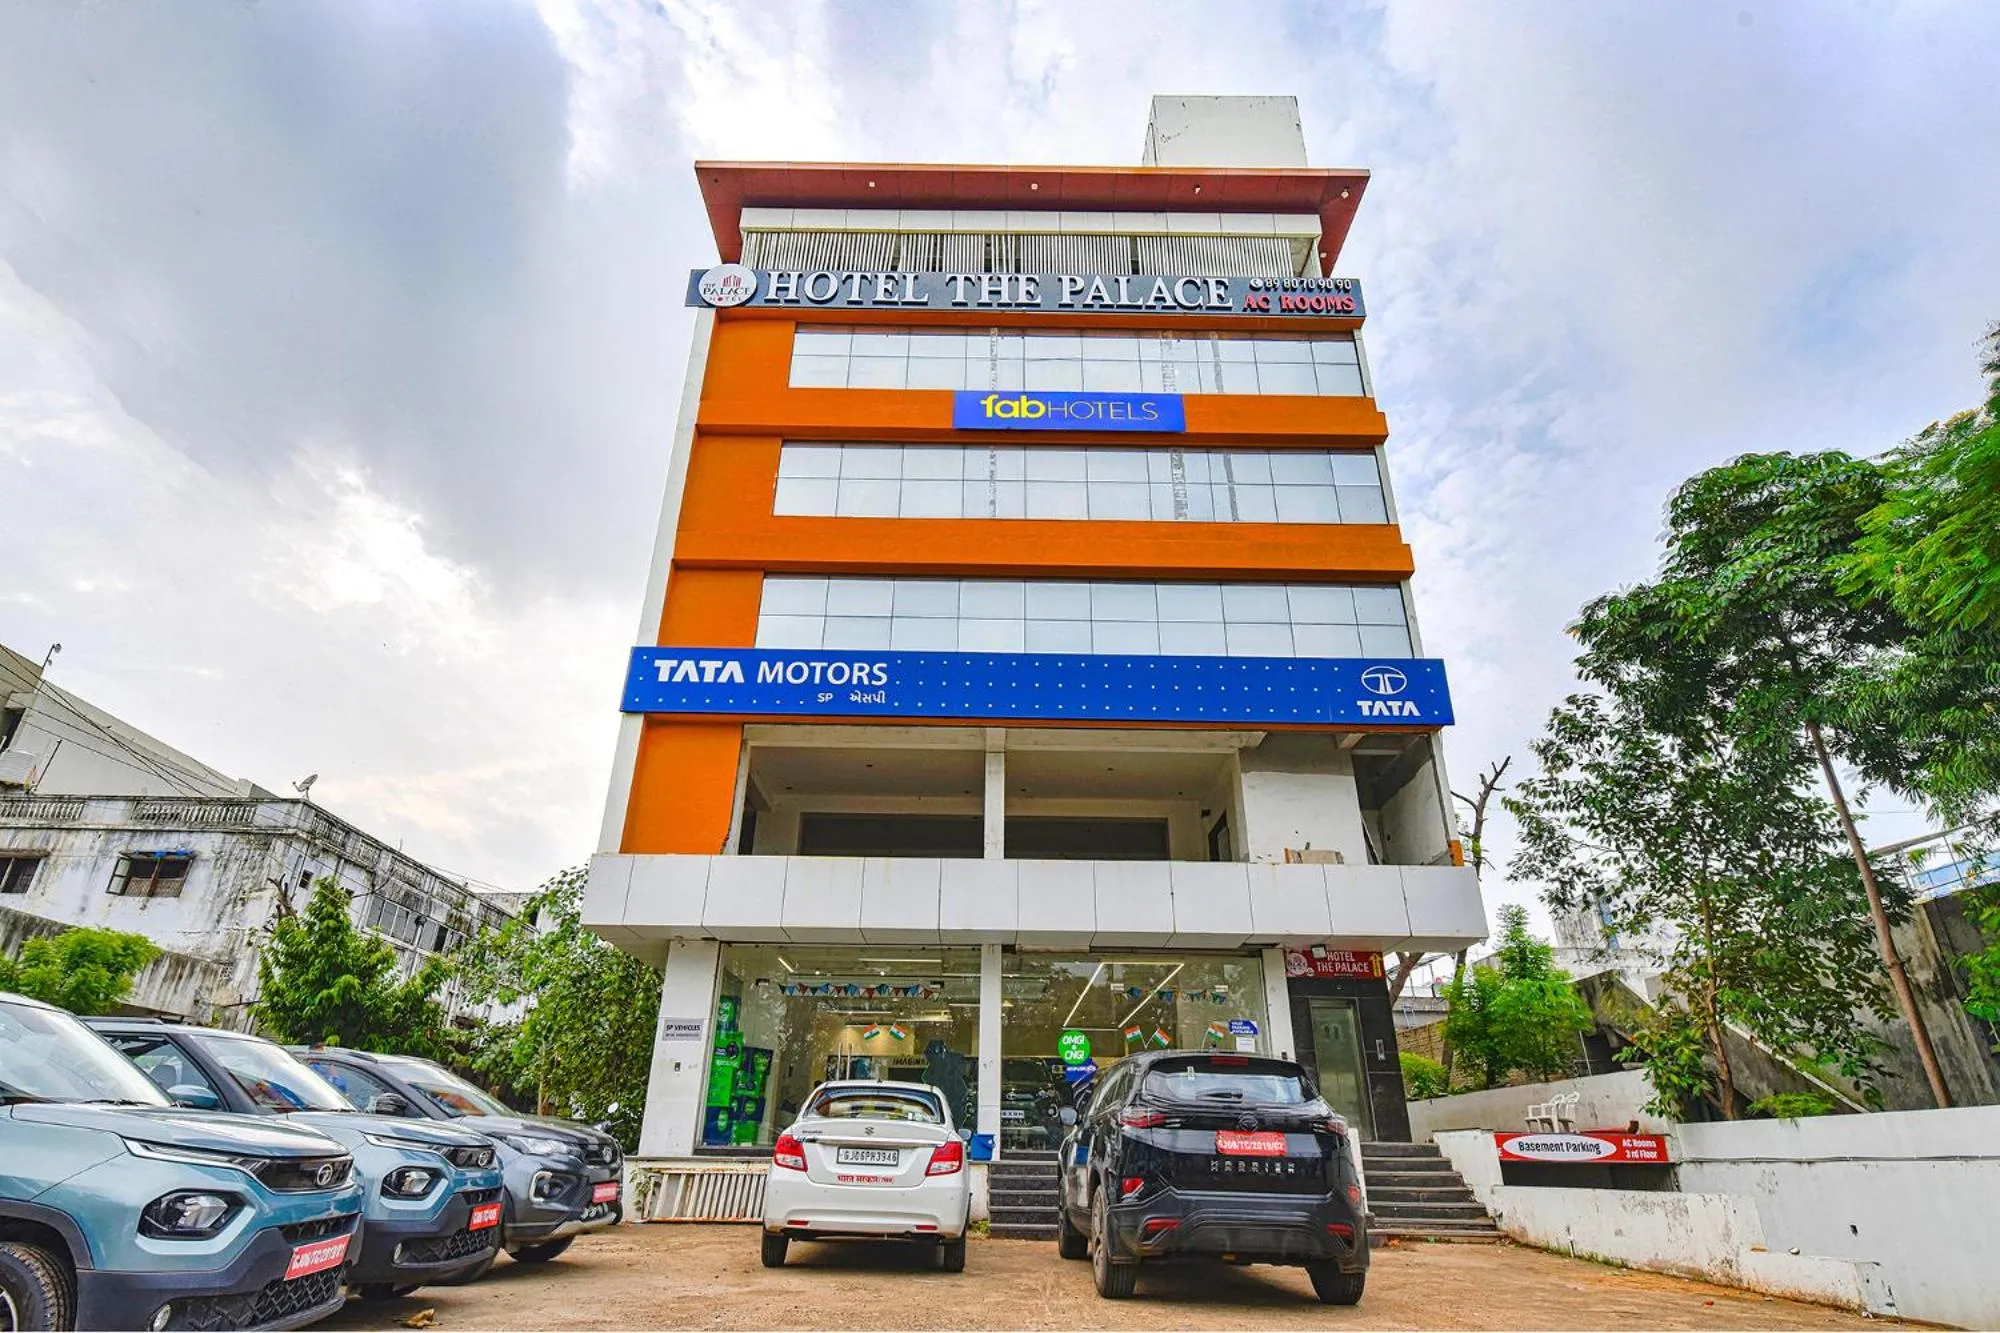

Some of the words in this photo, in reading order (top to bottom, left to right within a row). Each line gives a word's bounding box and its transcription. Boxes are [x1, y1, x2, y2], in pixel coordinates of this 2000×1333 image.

[764, 271, 929, 305] HOTEL
[945, 273, 1041, 307] THE
[1057, 275, 1233, 310] PALACE
[1242, 294, 1271, 312] AC
[1279, 294, 1358, 313] ROOMS
[653, 659, 745, 683] TATA
[757, 660, 888, 686] MOTORS
[817, 692, 834, 703] SP
[1356, 700, 1421, 717] TATA
[1327, 951, 1355, 962] HOTEL
[1317, 962, 1335, 972] THE
[1335, 962, 1370, 973] PALACE
[1518, 1141, 1565, 1152] Basement
[1566, 1141, 1602, 1155] Parking
